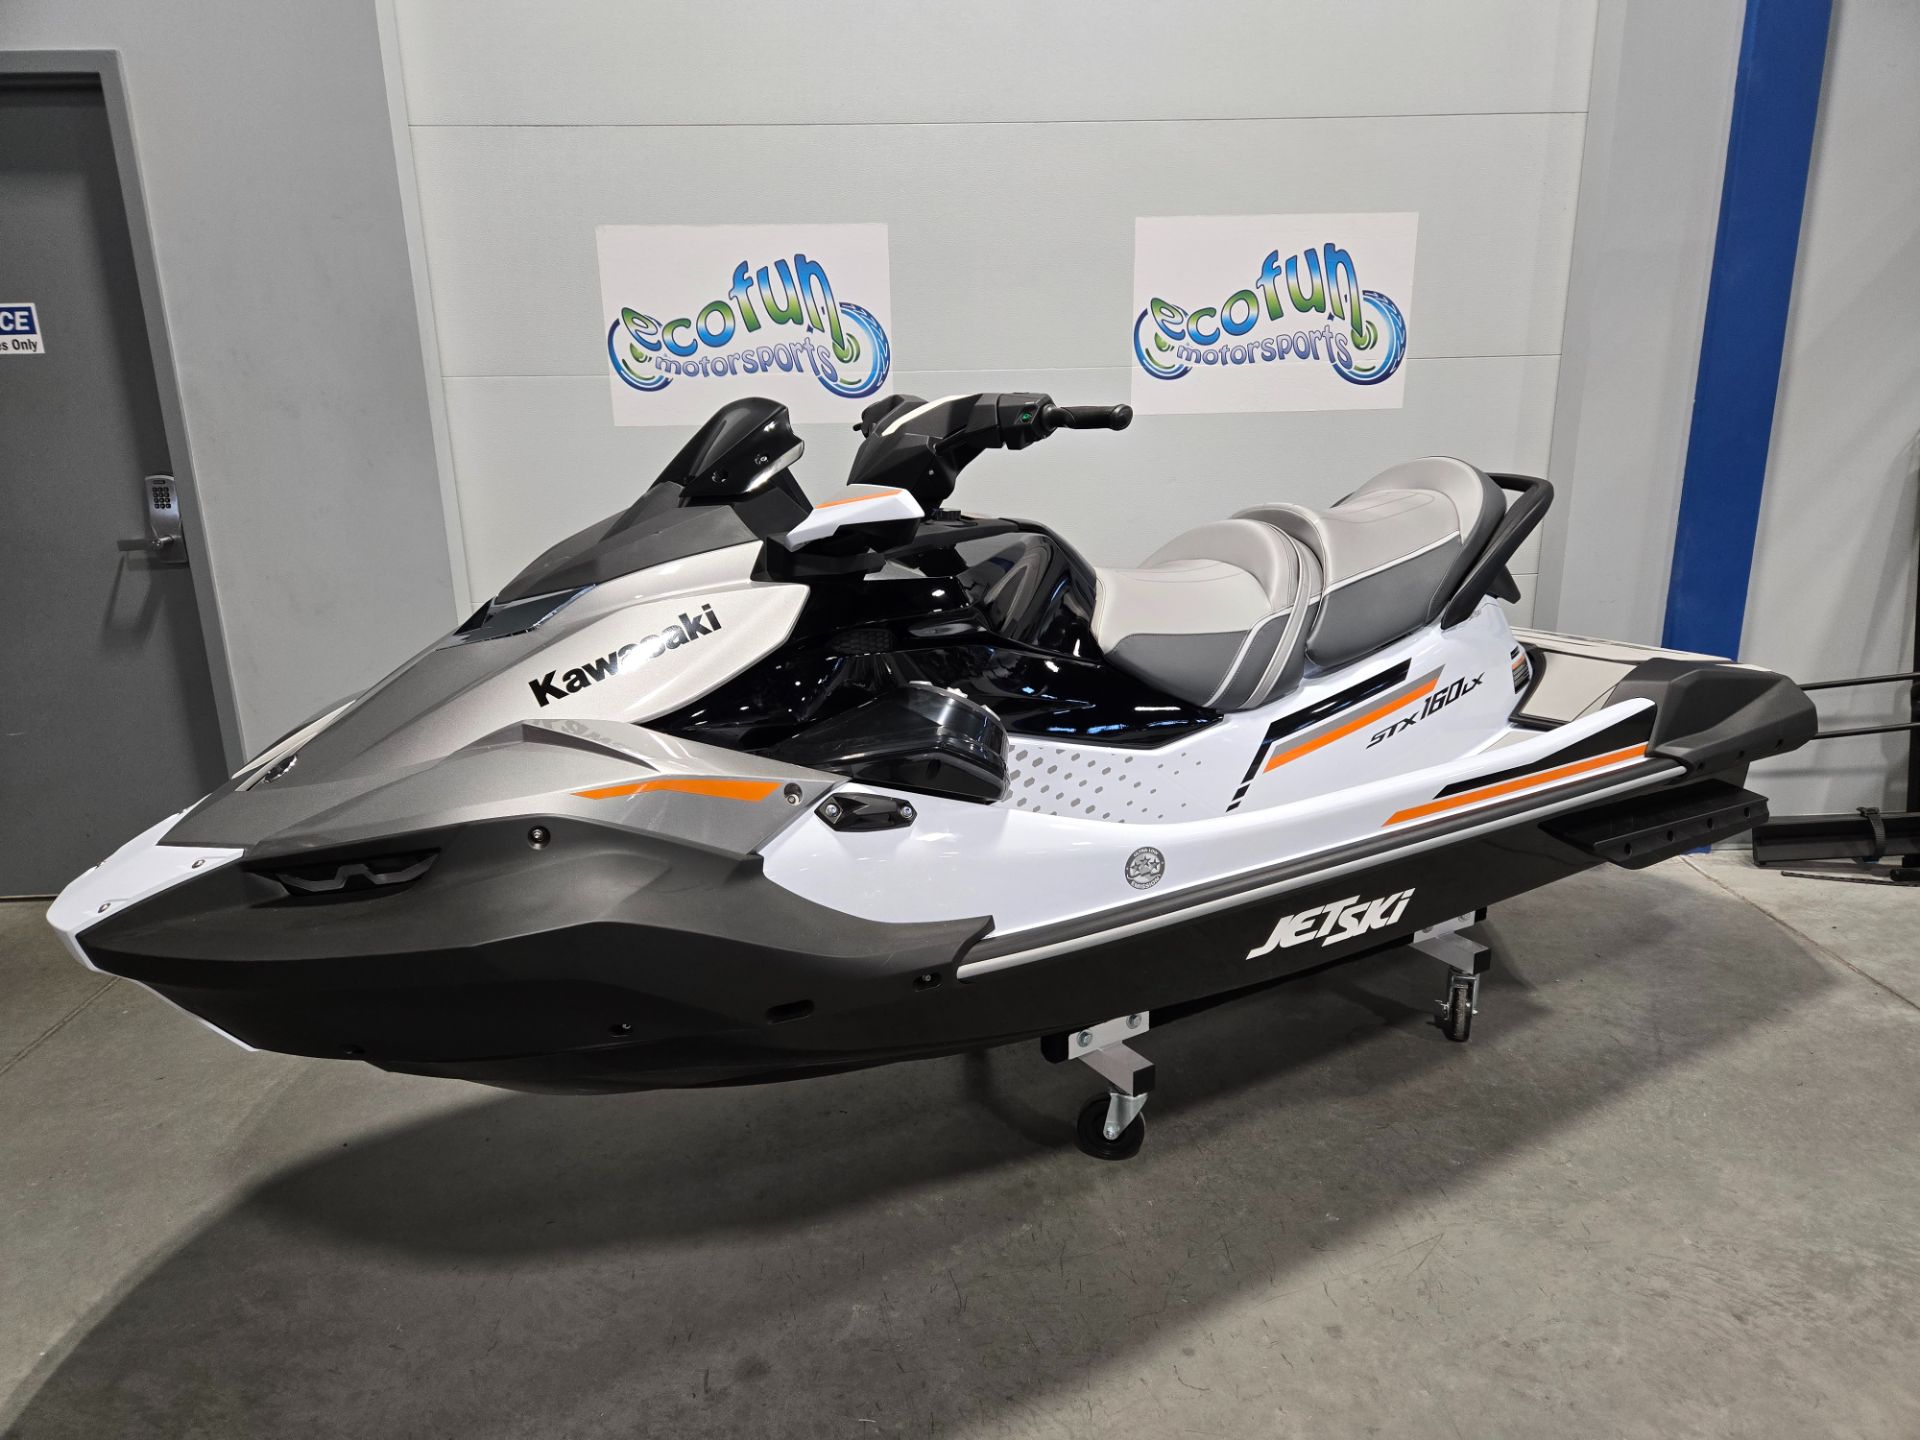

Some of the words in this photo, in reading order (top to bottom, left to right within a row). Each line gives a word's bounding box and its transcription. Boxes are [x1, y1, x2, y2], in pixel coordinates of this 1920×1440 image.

[621, 253, 845, 356] ecofun
[1150, 243, 1363, 345] ecofun
[0, 342, 9, 351] s
[12, 338, 38, 353] Only
[655, 337, 839, 383] motorsports
[1176, 324, 1353, 370] motorsports
[1131, 874, 1160, 889] ESSION
